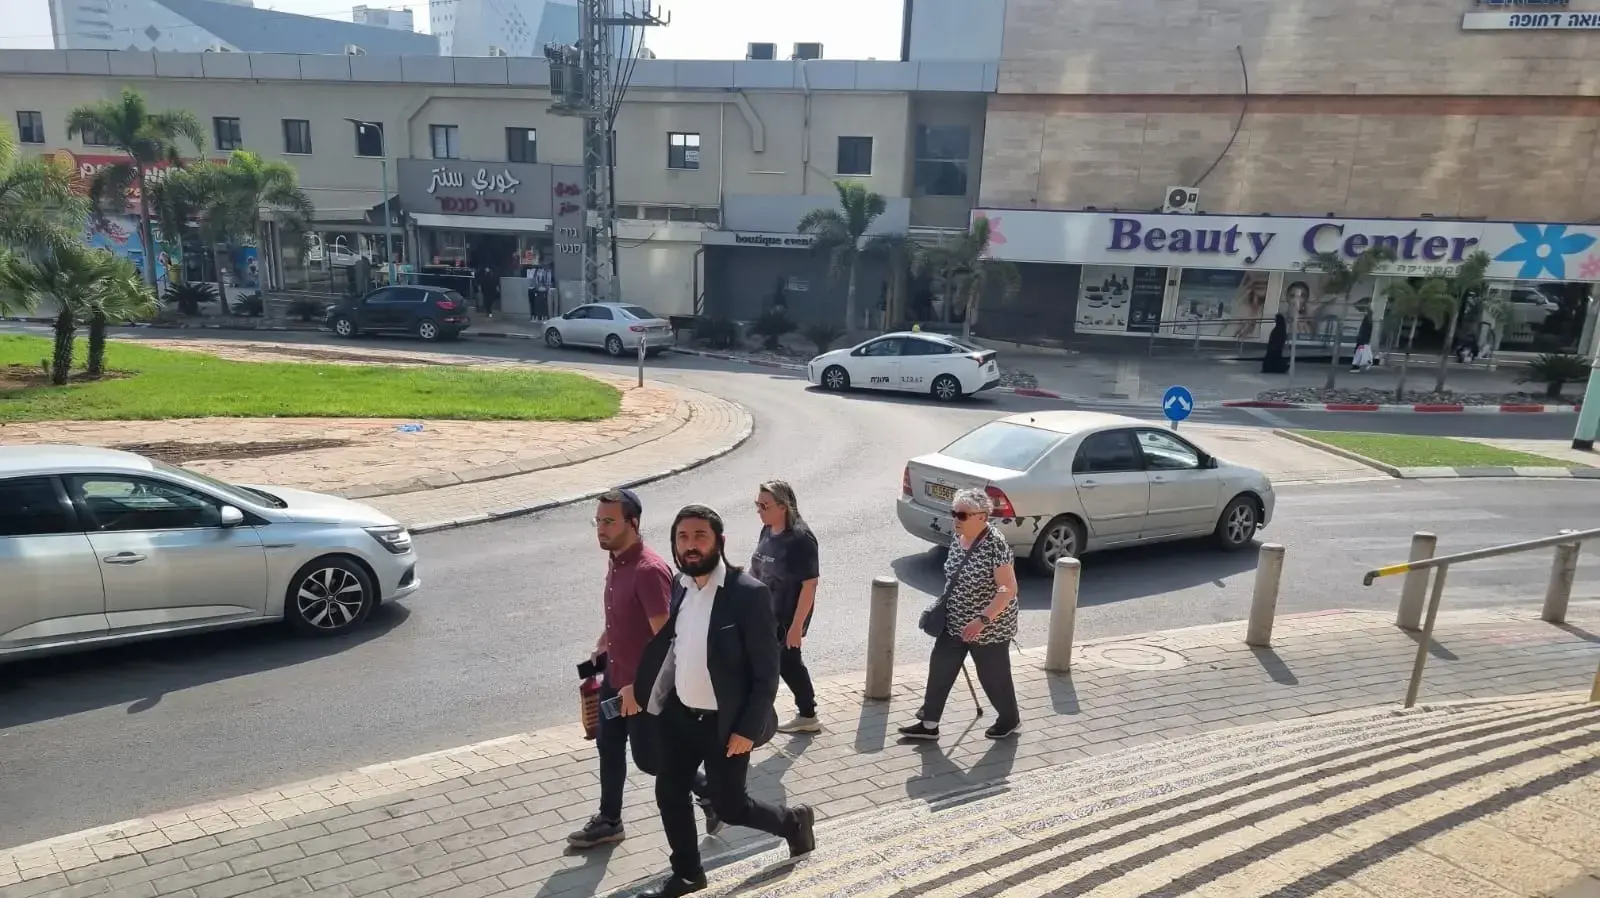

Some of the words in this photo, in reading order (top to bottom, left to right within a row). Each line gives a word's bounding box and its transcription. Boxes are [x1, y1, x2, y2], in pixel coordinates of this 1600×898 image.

[1509, 14, 1562, 27] דחופה
[1568, 14, 1600, 27] ואה
[427, 166, 463, 194] سنتر
[471, 168, 520, 196] جوري
[735, 233, 782, 246] boutique
[1106, 218, 1276, 264] Beauty
[1302, 222, 1479, 263] Center
